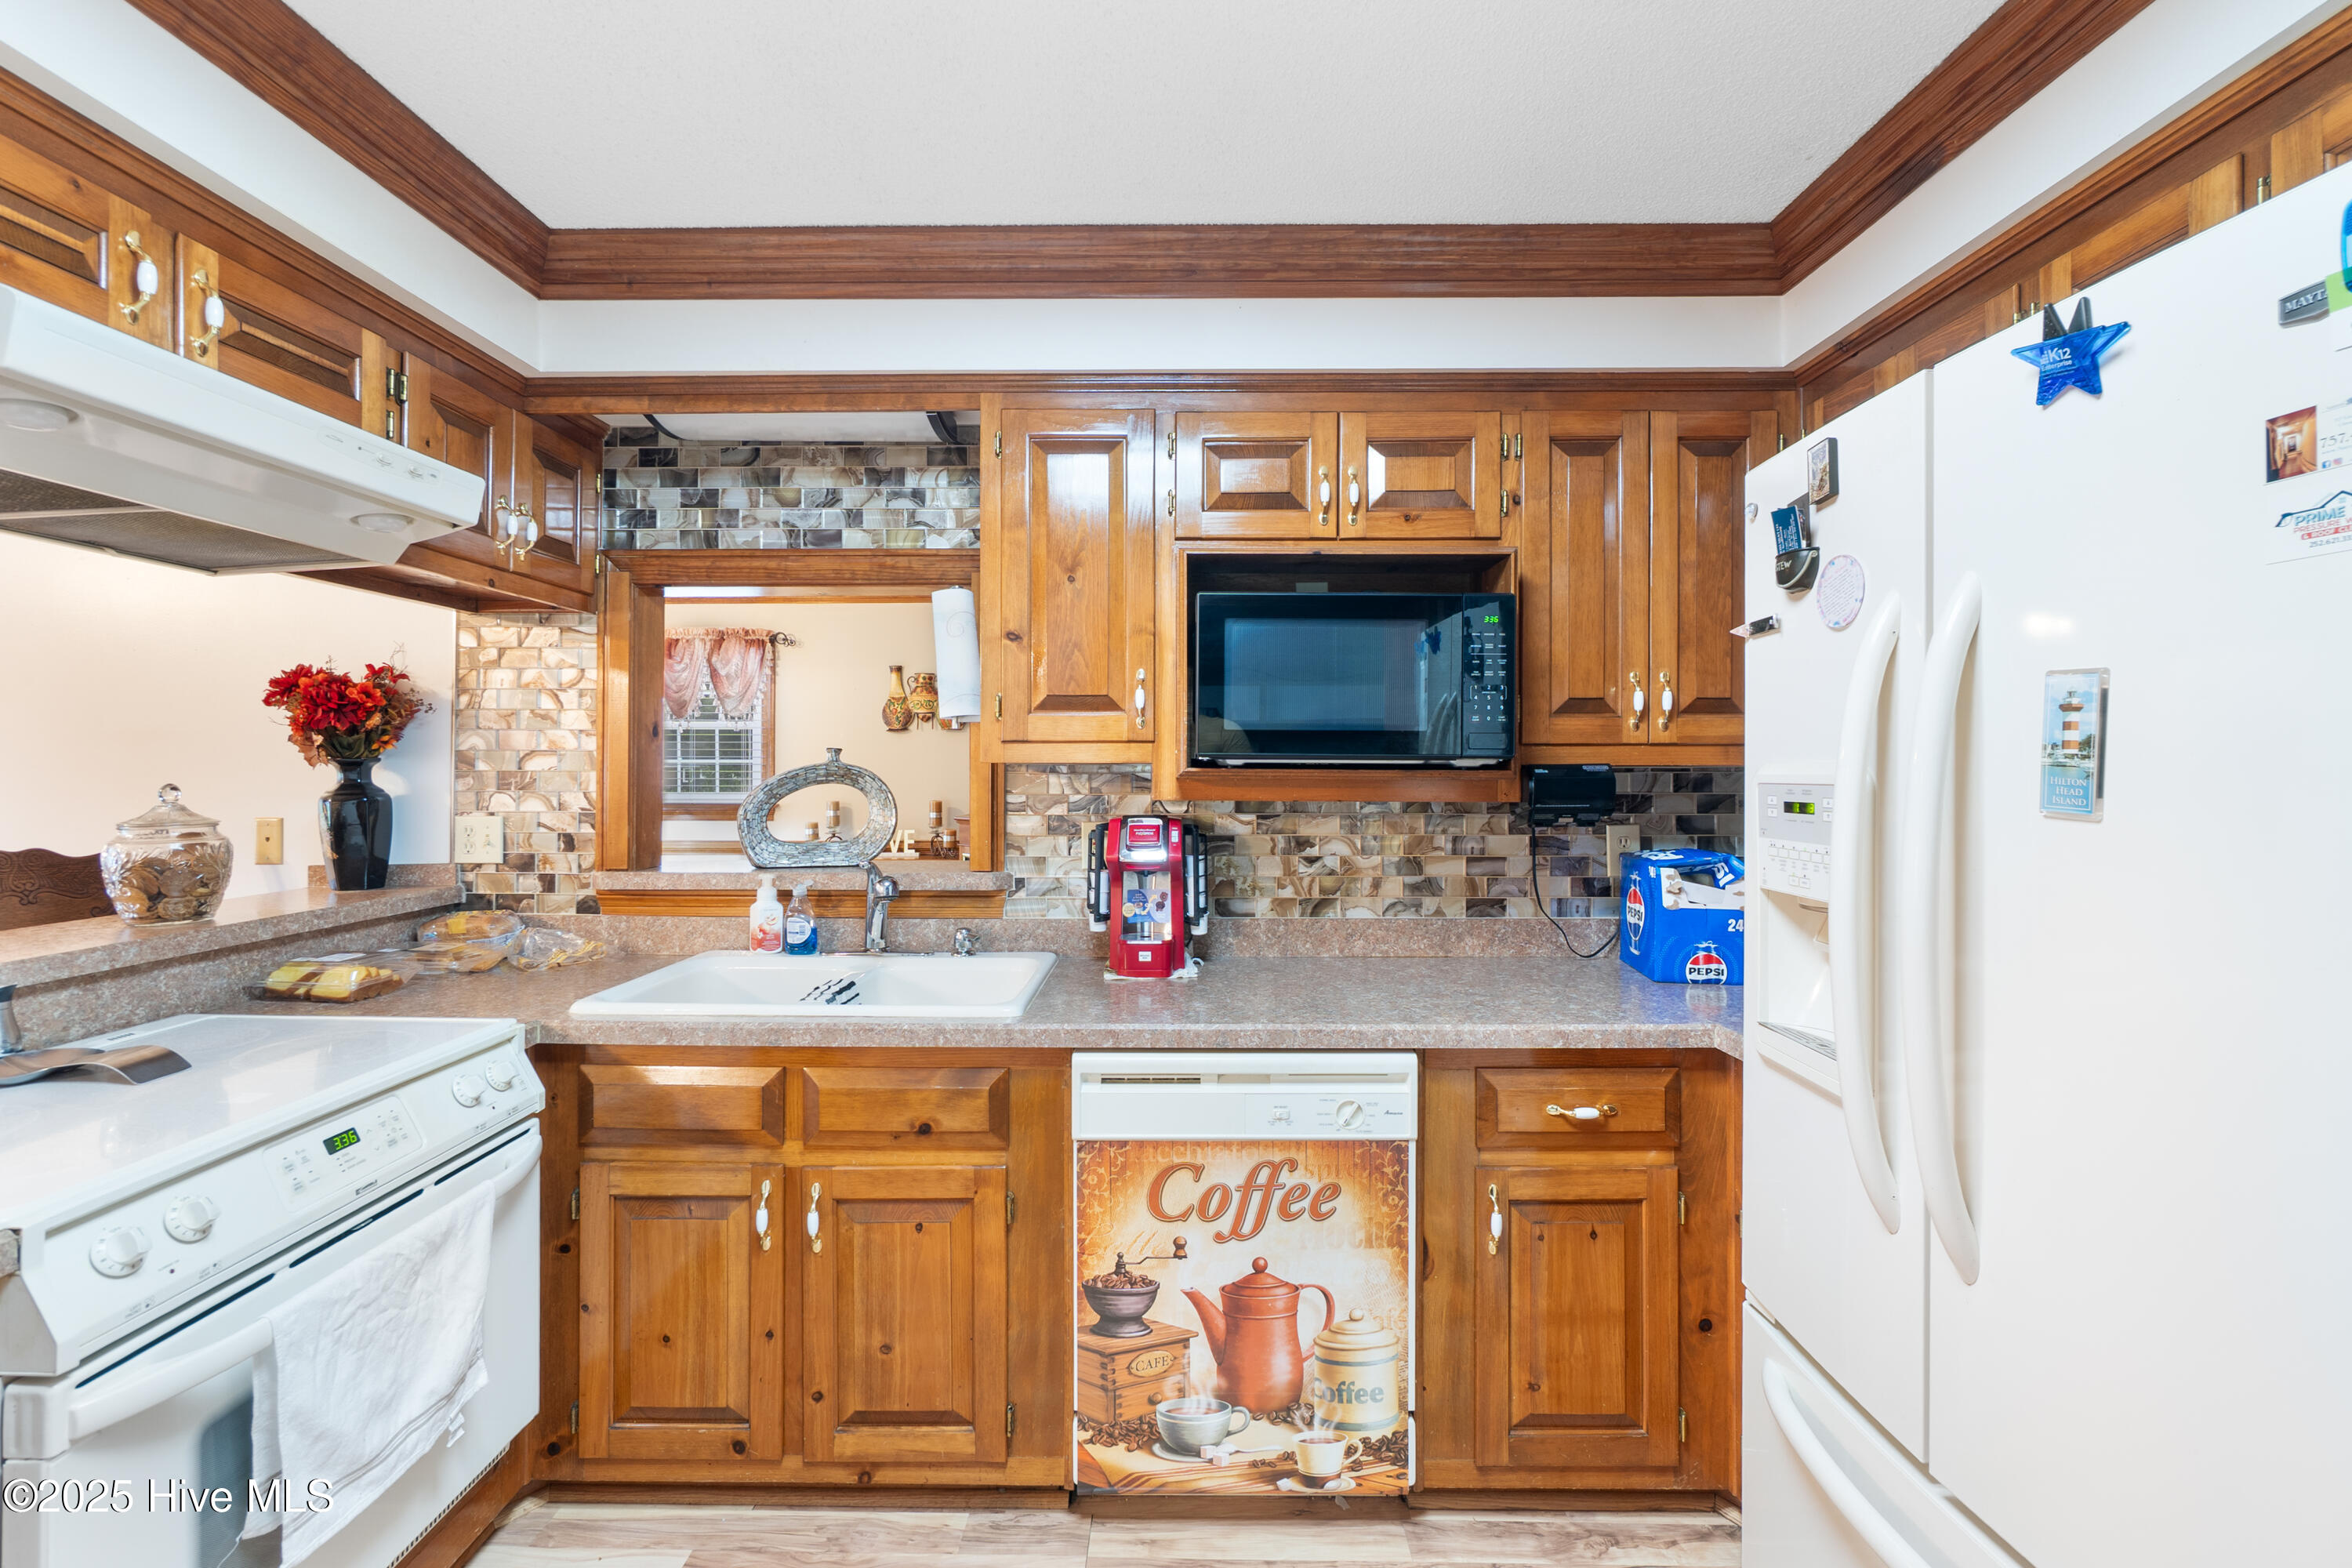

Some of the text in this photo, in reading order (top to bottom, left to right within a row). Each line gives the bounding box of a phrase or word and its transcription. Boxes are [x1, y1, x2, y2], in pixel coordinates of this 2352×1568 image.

[2048, 347, 2071, 361] K12
[2295, 506, 2346, 526] PRIME
[2293, 518, 2340, 533] PRESSURE
[2050, 776, 2087, 786] HILTON
[2056, 786, 2083, 796] HEAD
[2052, 796, 2086, 806] ISLAND
[1627, 905, 1643, 922] PEPSI
[1727, 918, 1744, 933] 24
[1688, 966, 1725, 977] PEPSI
[1147, 1156, 1341, 1243] Coffee
[1135, 1355, 1170, 1372] CAFE
[1314, 1377, 1385, 1404] Coffee
